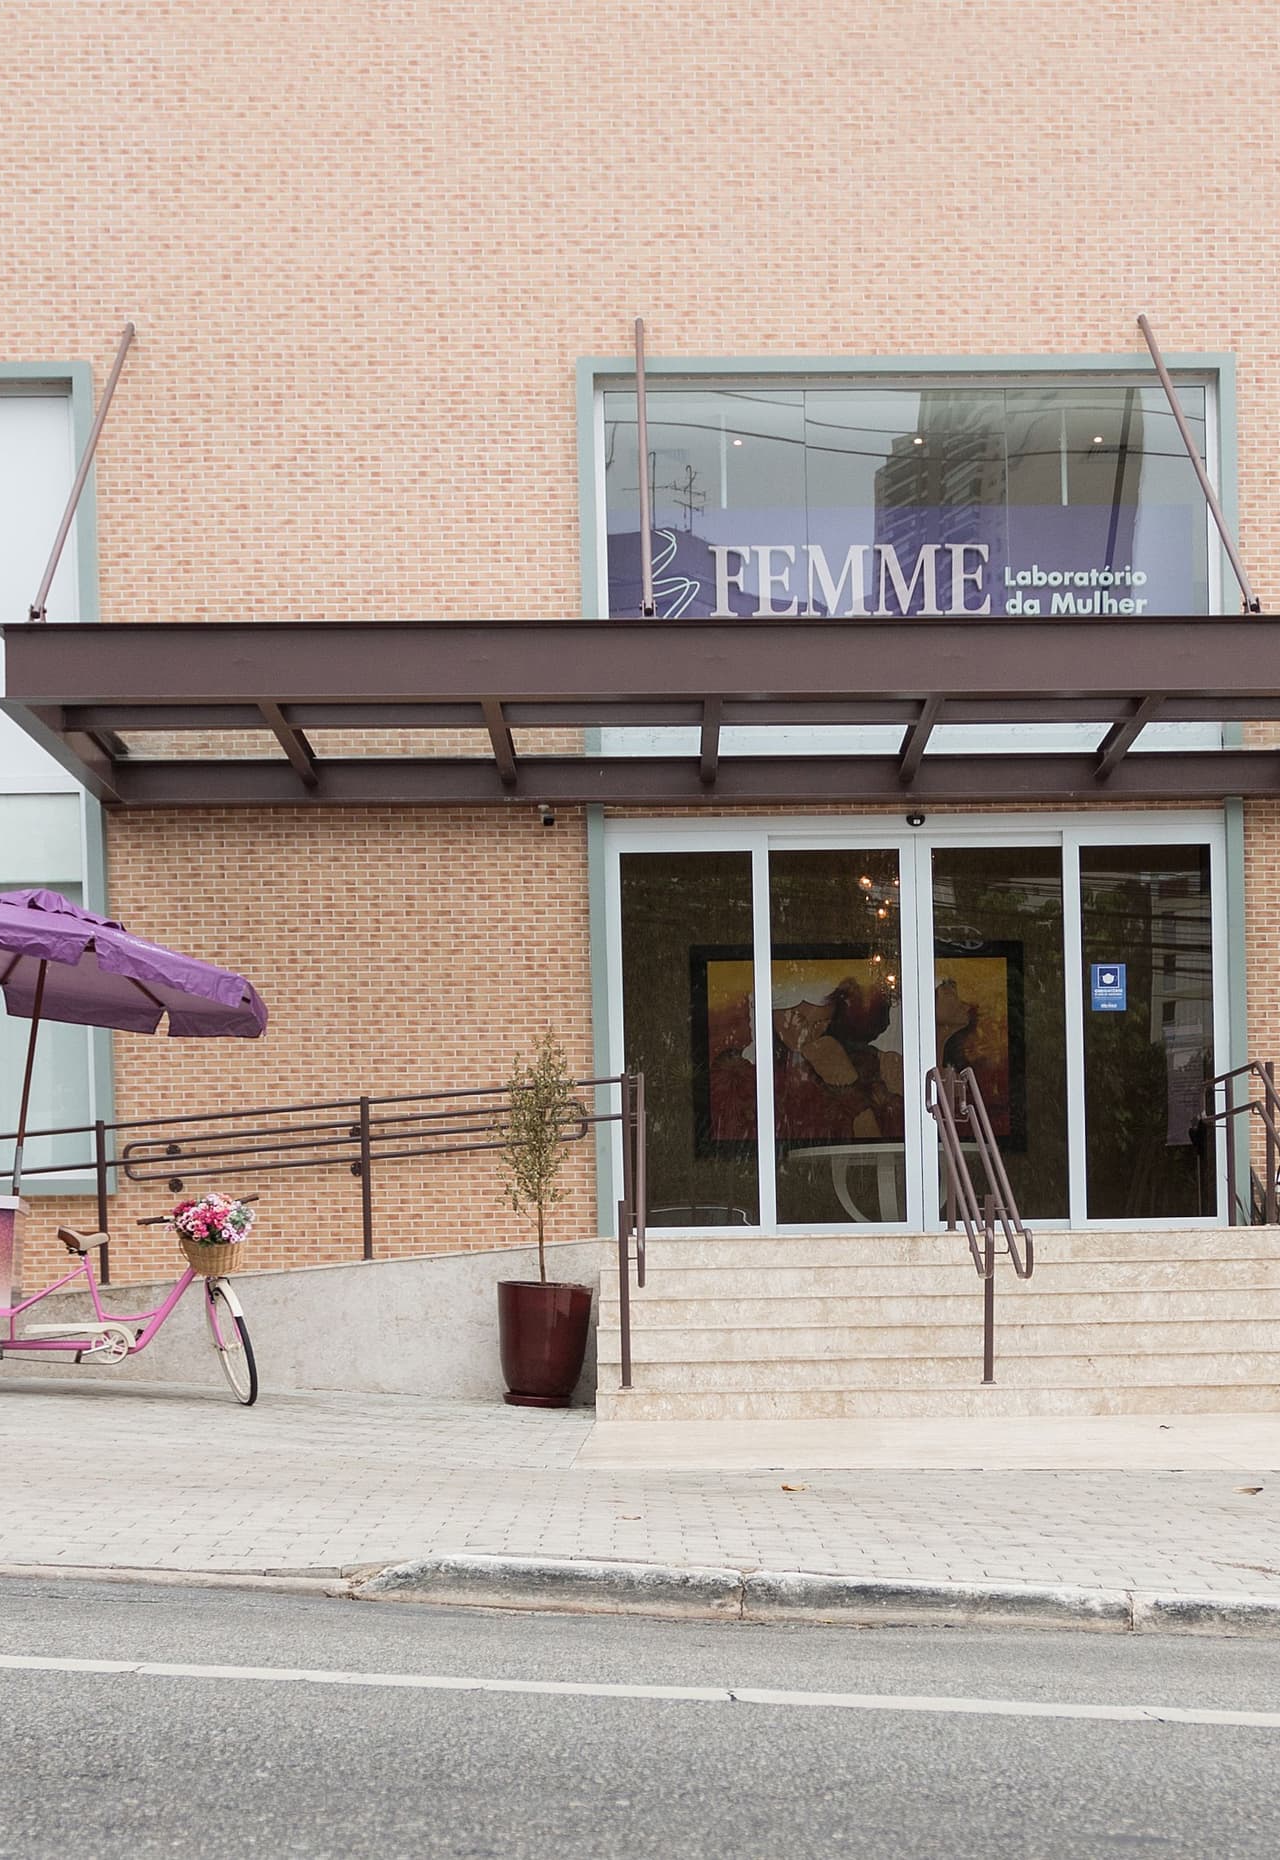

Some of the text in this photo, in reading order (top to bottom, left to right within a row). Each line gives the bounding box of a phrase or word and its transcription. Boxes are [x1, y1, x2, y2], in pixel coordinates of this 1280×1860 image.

[708, 543, 991, 617] FEMME
[1004, 564, 1148, 587] Laboratório
[1005, 590, 1148, 614] da Mulher
